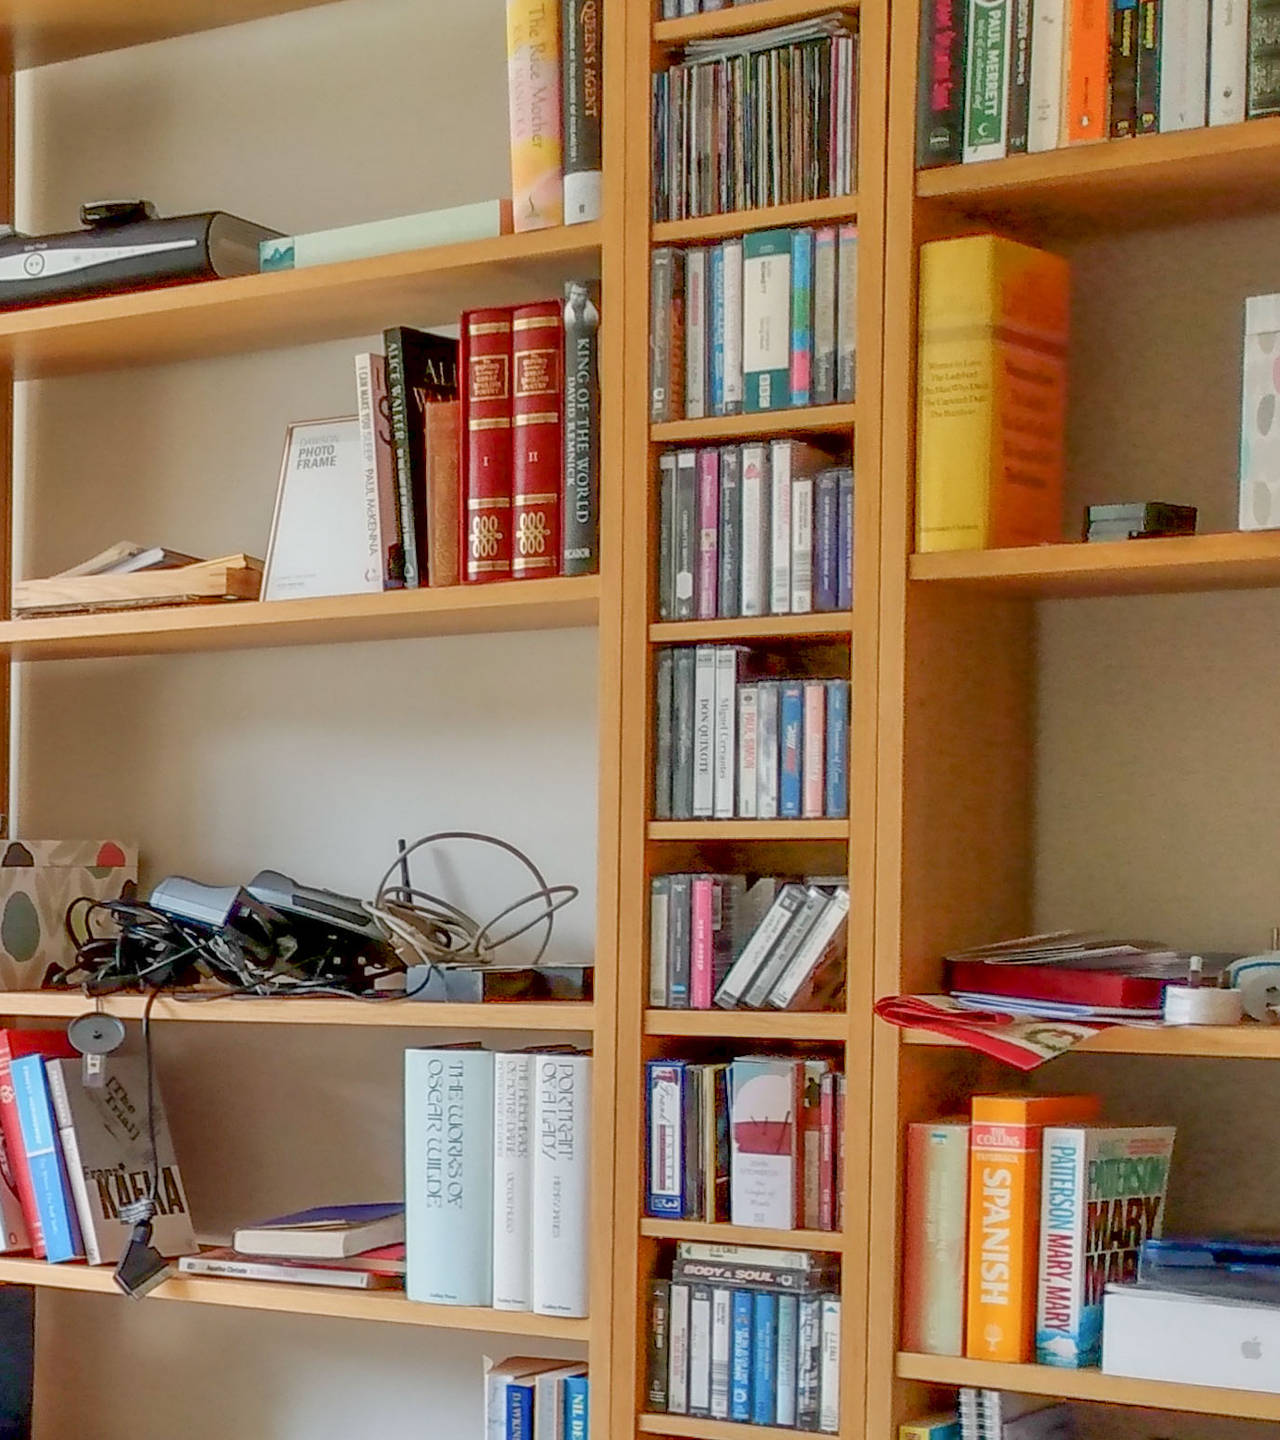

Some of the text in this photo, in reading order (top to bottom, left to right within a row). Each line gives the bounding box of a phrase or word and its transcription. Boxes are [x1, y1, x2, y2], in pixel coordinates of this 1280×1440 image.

[529, 4, 545, 37] The
[984, 10, 1002, 117] PAUL MERRETT
[531, 86, 547, 148] Mother
[584, 69, 596, 117] AGENT
[388, 342, 402, 380] ALICE
[391, 385, 404, 439] WALKER
[576, 338, 589, 524] KING OF THE WORLD
[296, 444, 337, 470] PHOTO FRAME
[364, 469, 375, 496] PAUL
[528, 451, 538, 462] II
[717, 698, 728, 731] Miguel
[743, 713, 754, 768] PAUL SIMON
[698, 725, 709, 775] QUIXOTE
[426, 1060, 442, 1208] OSCAR WILDE
[448, 1062, 463, 1208] THE WORKS OF
[542, 1062, 556, 1160] OF A LADY
[559, 1064, 573, 1160] PORTRAIT
[977, 1134, 1020, 1148] COLLINS
[981, 1168, 1011, 1306] SPANISH
[1042, 1145, 1077, 1333] PATTERSON MARY, MARY
[1086, 1197, 1162, 1253] MARY
[683, 1264, 725, 1277] BODY
[735, 1270, 774, 1283] SOUL
[571, 1394, 584, 1418] NIL
